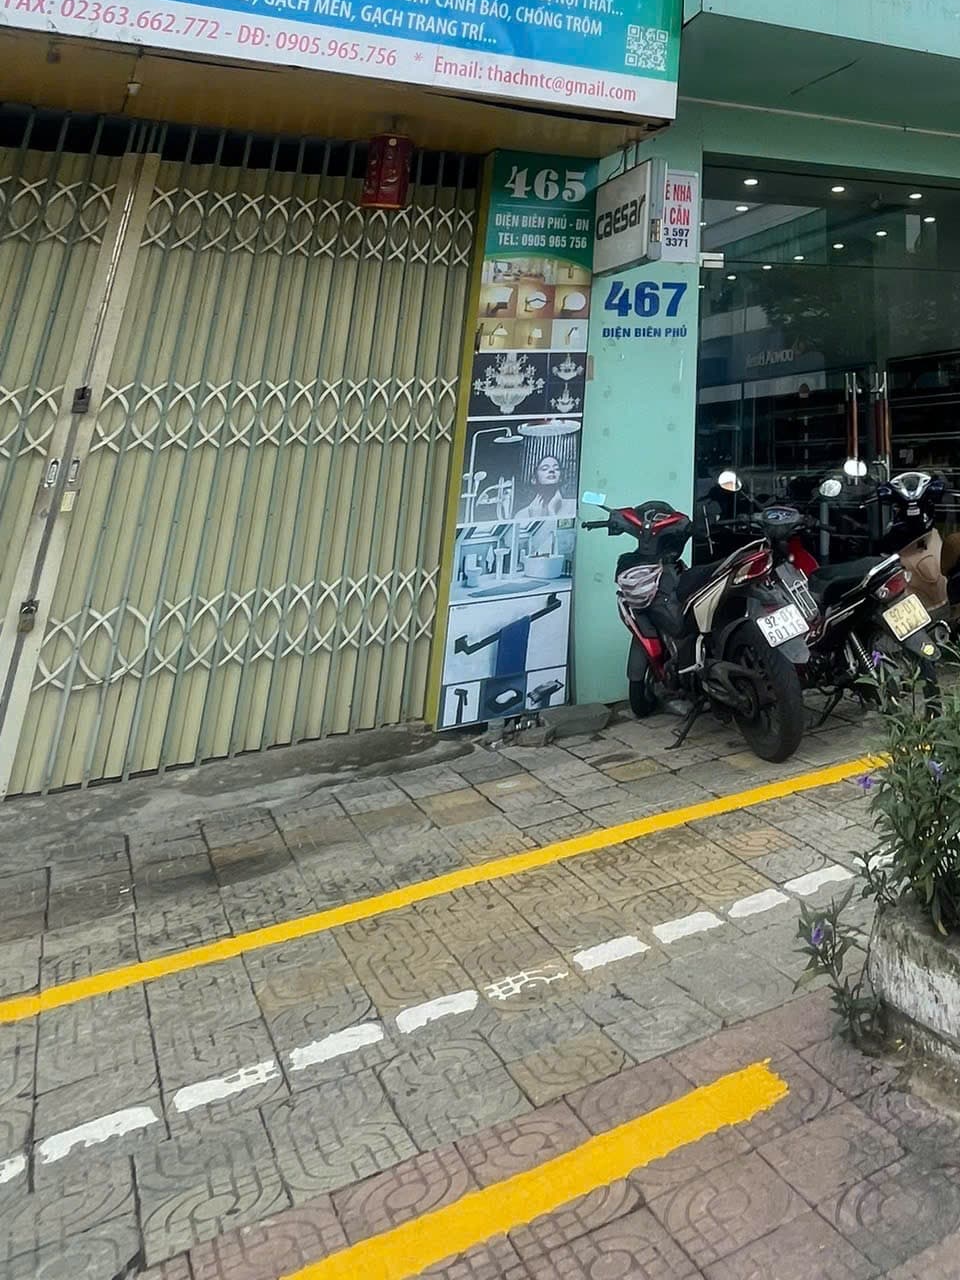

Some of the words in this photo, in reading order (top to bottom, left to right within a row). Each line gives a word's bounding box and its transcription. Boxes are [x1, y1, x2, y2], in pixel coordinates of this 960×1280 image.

[361, 5, 403, 29] GẠCH
[407, 12, 457, 37] TRANG
[462, 20, 497, 45] TRÍ...
[515, 5, 562, 30] CHỐNG
[566, 15, 602, 38] TRỘM
[238, 25, 271, 47] DĐ:
[275, 31, 397, 67] 0905.965.756
[434, 55, 483, 80] Email:
[487, 65, 637, 102] thachntc@gmail.com
[504, 166, 588, 202] 465
[495, 213, 519, 232] ĐIỆN
[521, 213, 545, 229] BIÊN
[547, 214, 567, 229] PHỦ
[672, 228, 690, 237] 597
[498, 232, 519, 246] TEL:
[521, 233, 546, 247] 0905
[549, 234, 567, 248] 965
[569, 235, 587, 249] 756
[665, 238, 688, 248] 3371
[604, 280, 688, 317] 467
[602, 326, 631, 340] ĐIỆN
[634, 326, 661, 338] BIÊN
[664, 323, 687, 338] PHỦ
